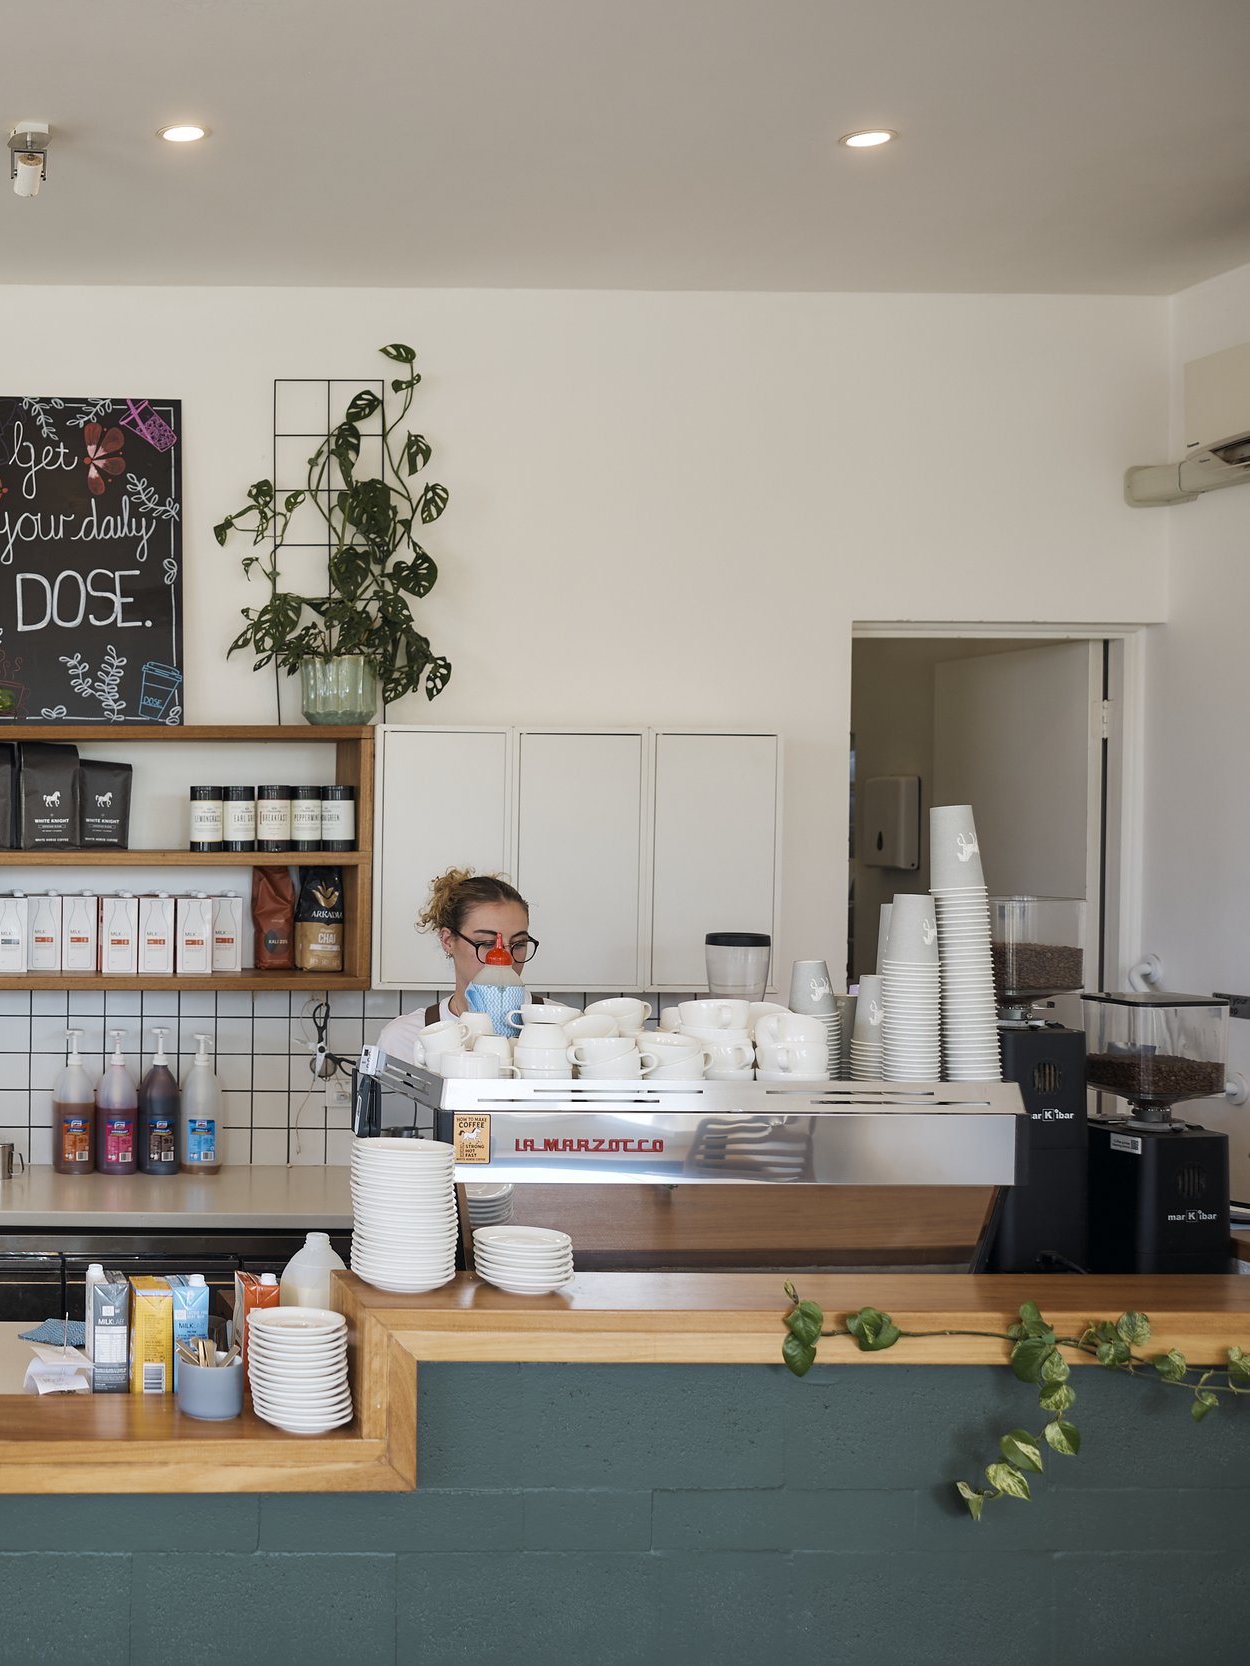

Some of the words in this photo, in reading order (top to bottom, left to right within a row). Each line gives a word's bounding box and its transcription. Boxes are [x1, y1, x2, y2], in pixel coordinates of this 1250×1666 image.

[71, 495, 156, 562] daily
[16, 569, 153, 631] DOSE.
[515, 1138, 535, 1152] LA
